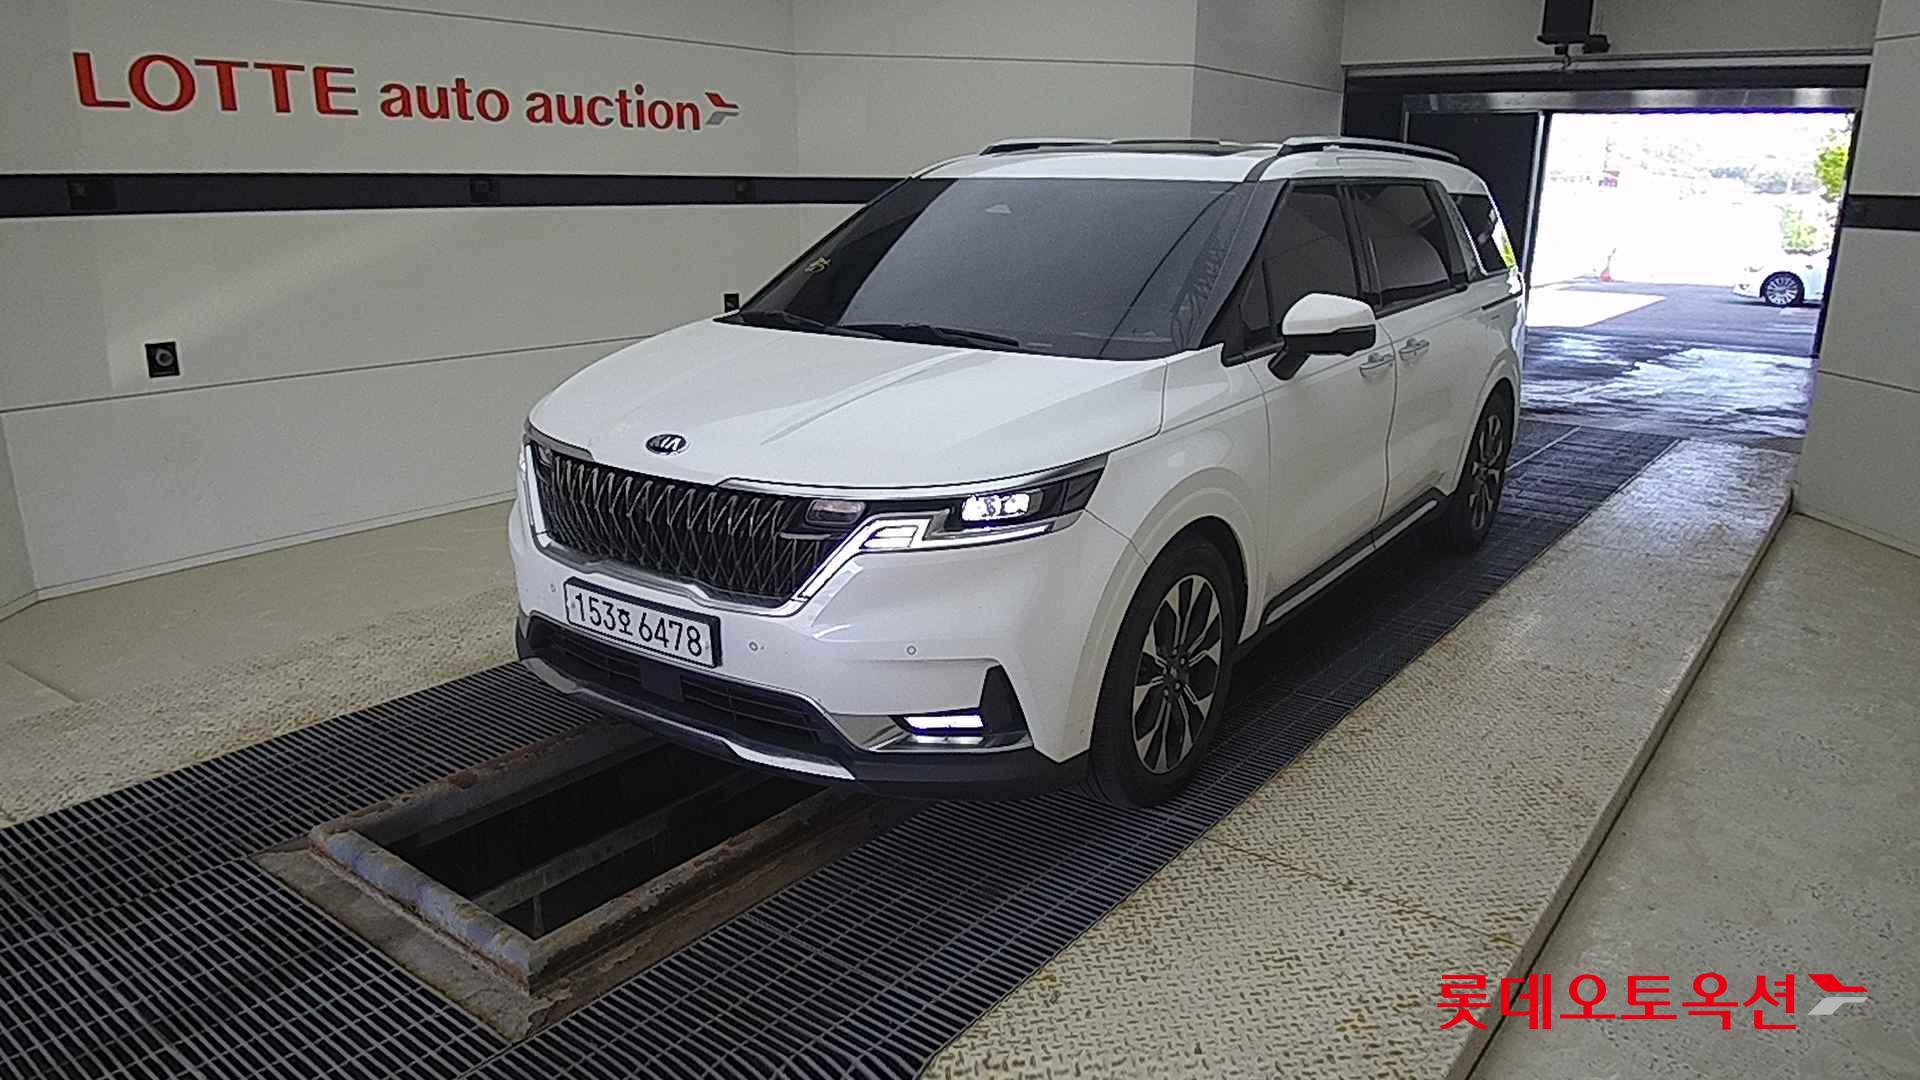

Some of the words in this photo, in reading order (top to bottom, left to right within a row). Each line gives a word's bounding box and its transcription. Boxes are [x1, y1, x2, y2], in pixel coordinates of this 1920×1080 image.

[73, 51, 358, 117] LOTTE
[379, 78, 512, 125] auto
[526, 84, 702, 132] auction
